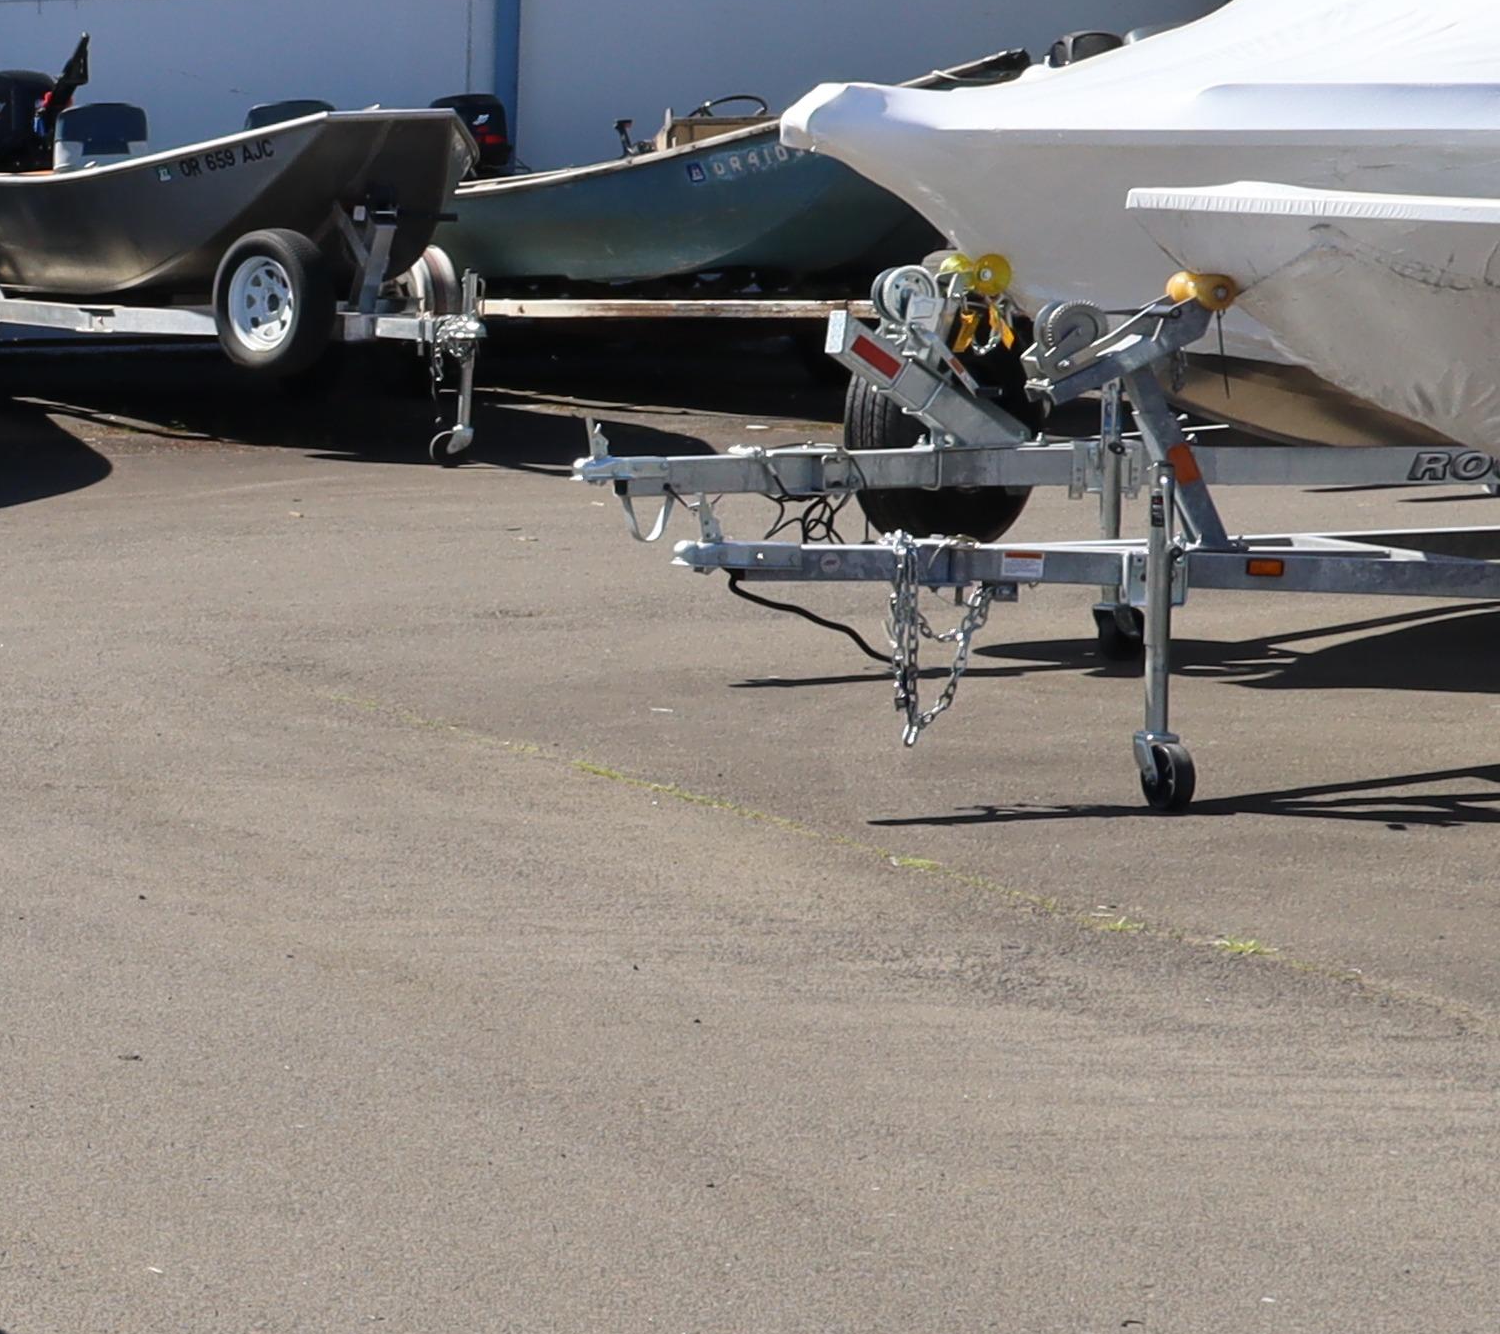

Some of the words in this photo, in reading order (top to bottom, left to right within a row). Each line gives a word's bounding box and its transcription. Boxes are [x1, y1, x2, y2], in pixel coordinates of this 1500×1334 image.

[180, 156, 202, 177] OR
[204, 148, 236, 171] 659
[242, 138, 275, 164] AJC
[1406, 450, 1500, 482] RO
